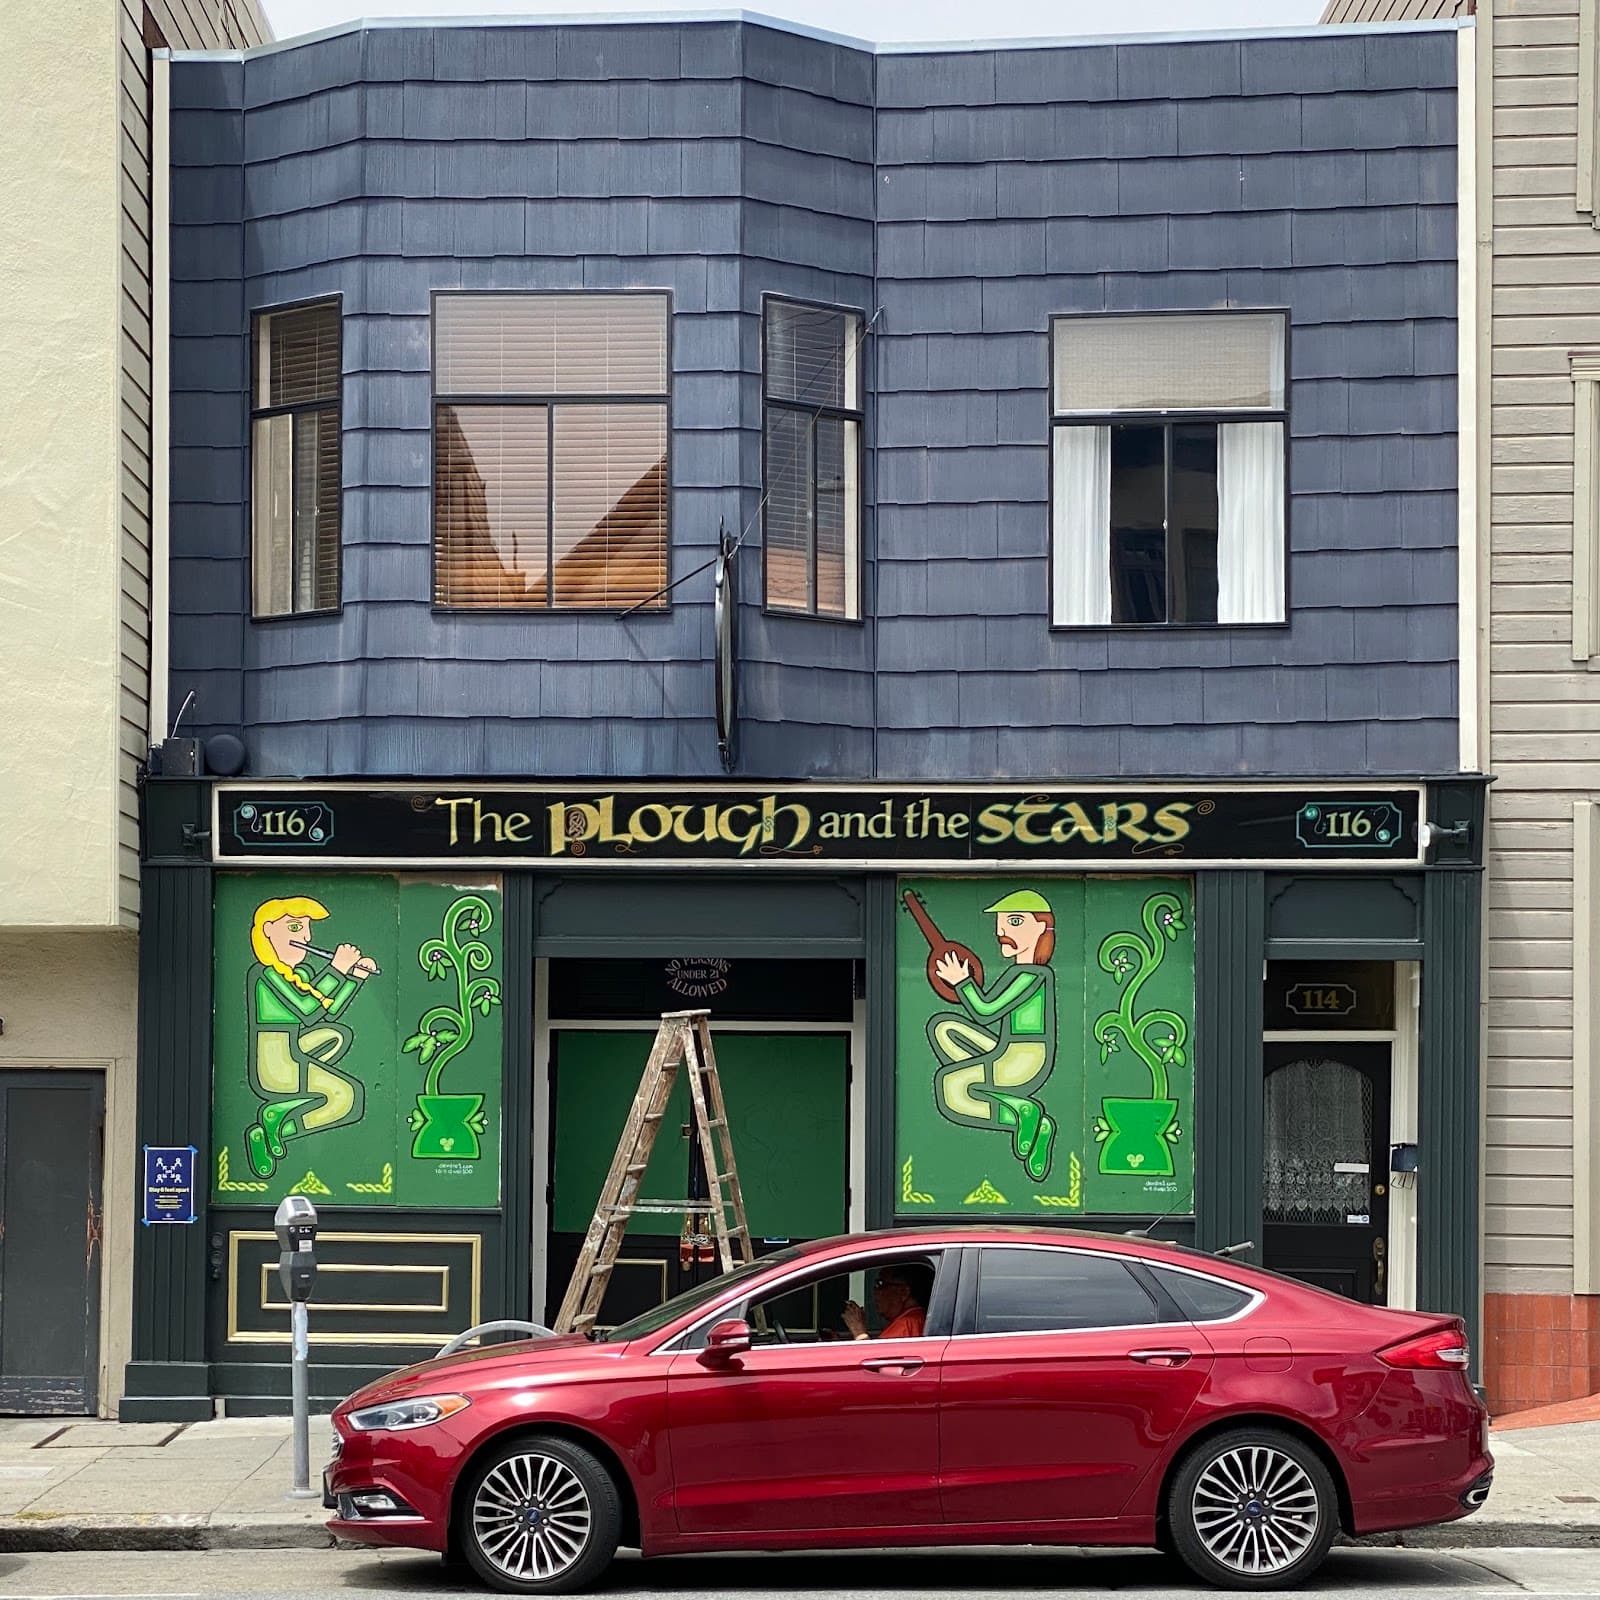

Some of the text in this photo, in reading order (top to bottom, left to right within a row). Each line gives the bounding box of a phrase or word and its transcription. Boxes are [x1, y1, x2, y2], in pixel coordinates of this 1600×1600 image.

[262, 809, 305, 836] 116
[435, 797, 533, 846] The
[818, 799, 897, 839] and
[903, 798, 970, 839] the
[1326, 810, 1372, 837] 116
[664, 959, 681, 975] NO
[677, 969, 719, 979] UNDER 21
[667, 978, 727, 998] ALLOWED
[1302, 990, 1339, 1009] 114
